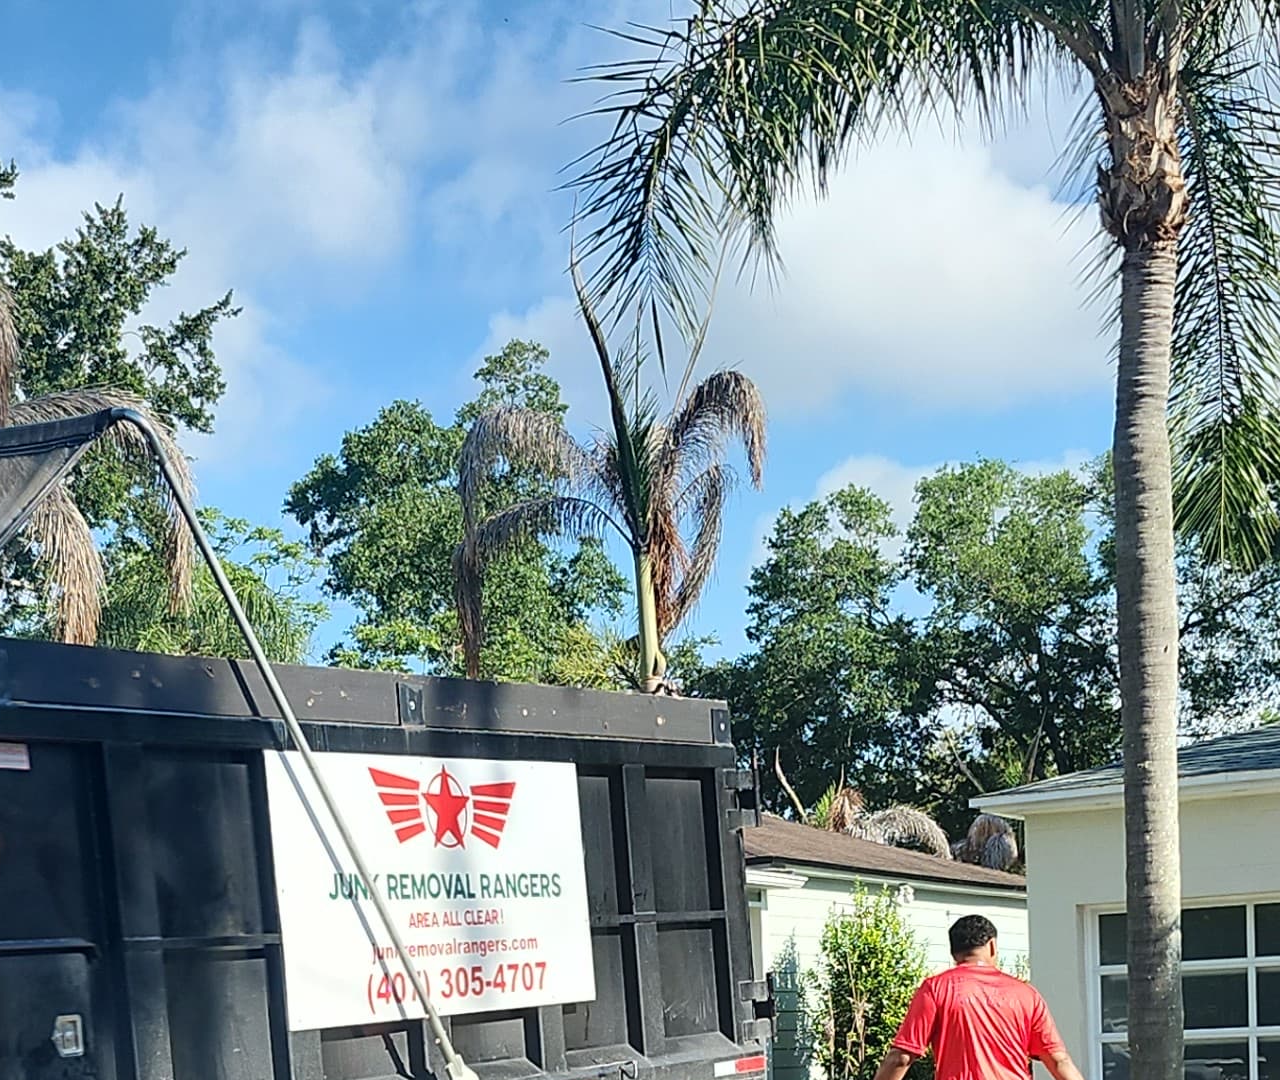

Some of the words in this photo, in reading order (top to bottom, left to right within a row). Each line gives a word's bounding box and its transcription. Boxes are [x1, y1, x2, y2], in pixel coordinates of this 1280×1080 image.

[387, 873, 476, 900] REMOVAL
[480, 873, 562, 898] RANGERS
[409, 912, 440, 928] AREA
[443, 910, 462, 927] ALL
[464, 908, 504, 926] CLEAR!
[440, 961, 547, 999] 305-4707
